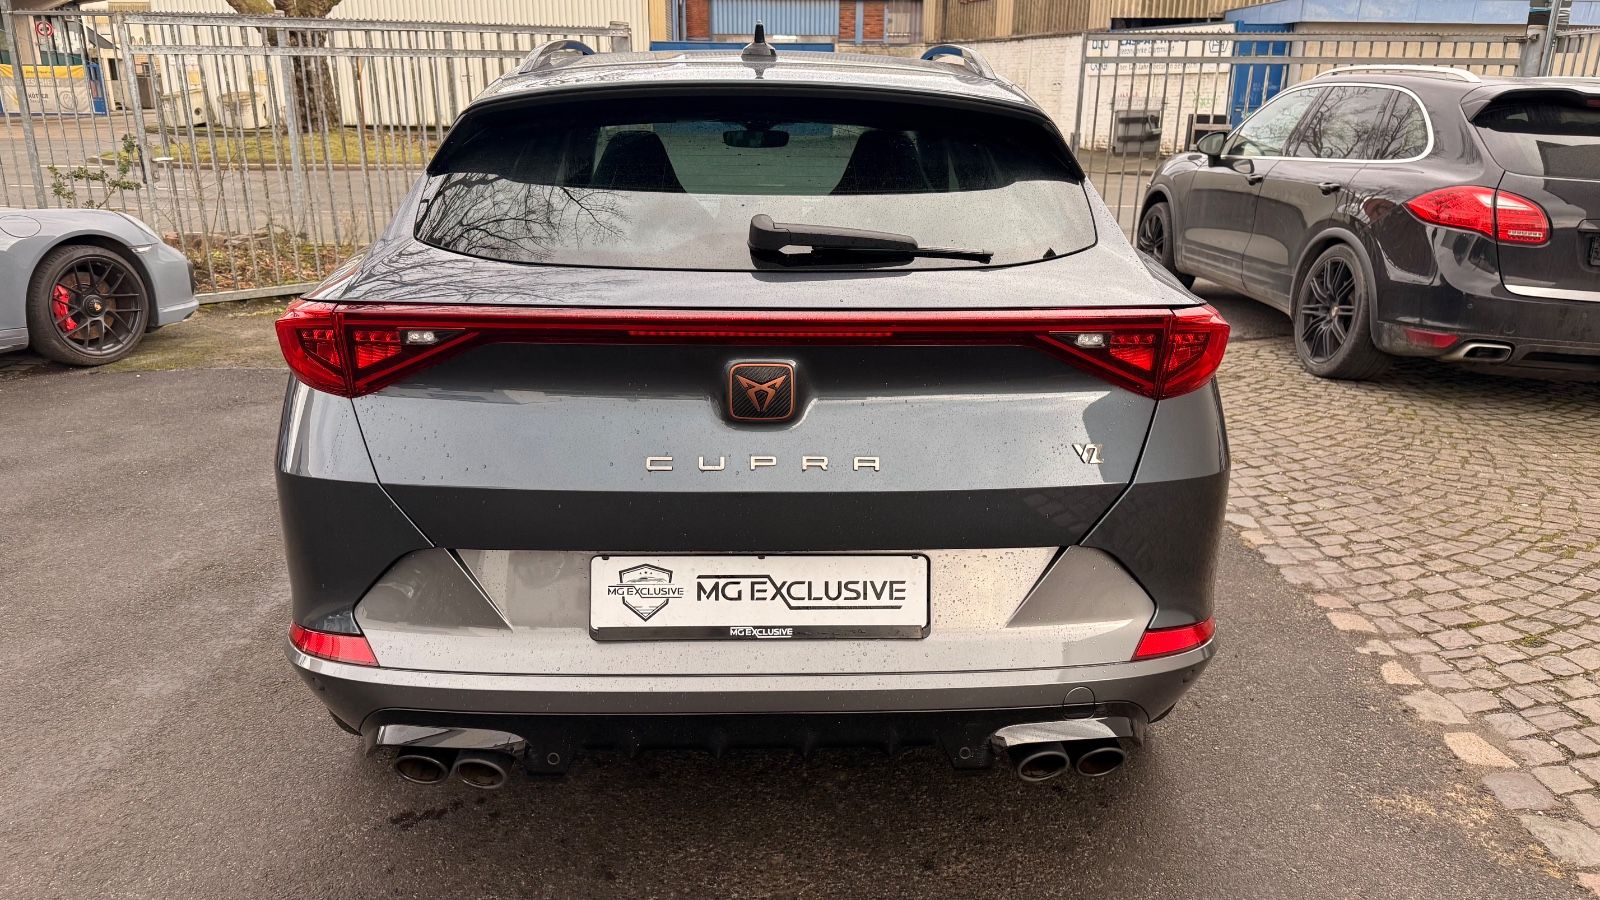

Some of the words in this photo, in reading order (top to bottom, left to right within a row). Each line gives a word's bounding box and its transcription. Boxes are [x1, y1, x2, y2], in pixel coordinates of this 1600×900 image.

[1071, 443, 1105, 464] VZ
[646, 455, 880, 472] CUPRA
[607, 587, 625, 596] MG
[627, 586, 684, 597] EXCLUSIVE
[696, 580, 743, 602] MG
[750, 579, 907, 602] EXCLUSIVE
[730, 627, 745, 636] MG
[746, 627, 793, 637] EXCLUSIVE
